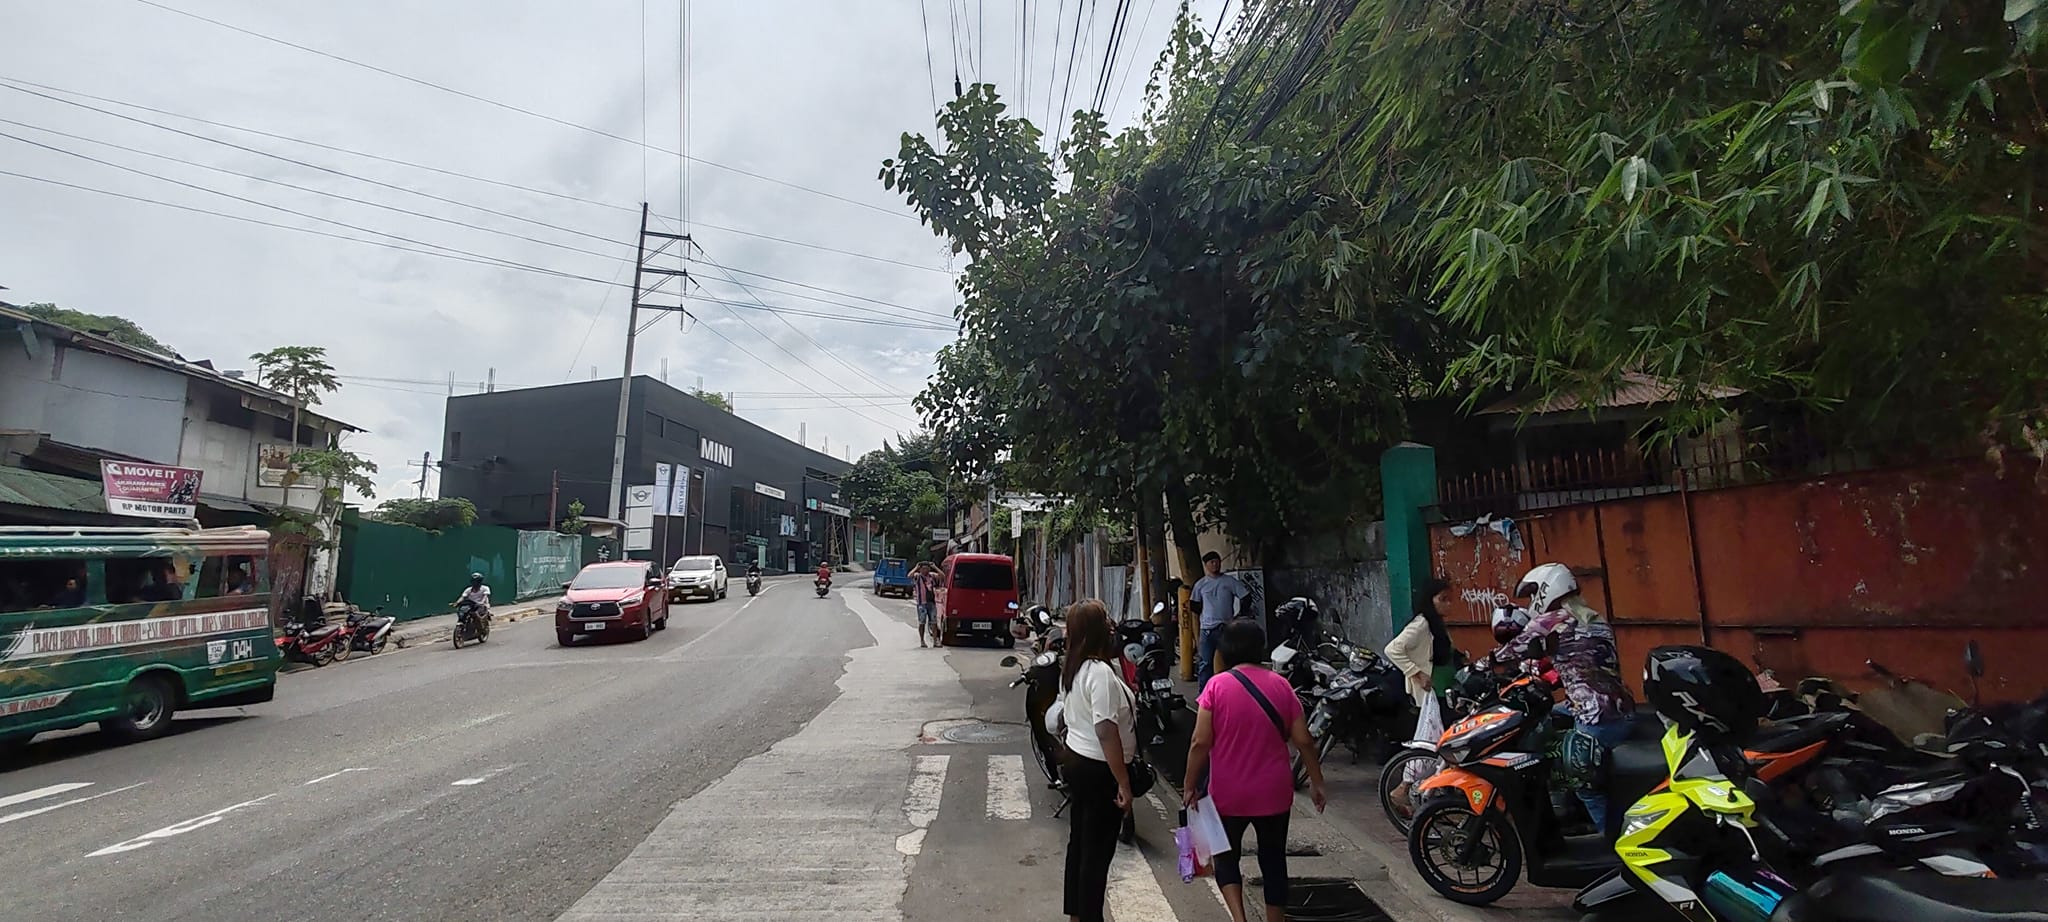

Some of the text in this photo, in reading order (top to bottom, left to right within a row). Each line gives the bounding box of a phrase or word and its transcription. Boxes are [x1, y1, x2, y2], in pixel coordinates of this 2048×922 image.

[701, 437, 733, 468] MINI
[124, 466, 177, 479] MOVE IT
[134, 503, 162, 513] MOTOR
[163, 505, 187, 515] PARTS
[1513, 758, 1540, 771] HONDA
[1888, 827, 1926, 836] HONDA
[1624, 850, 1649, 858] HONDA
